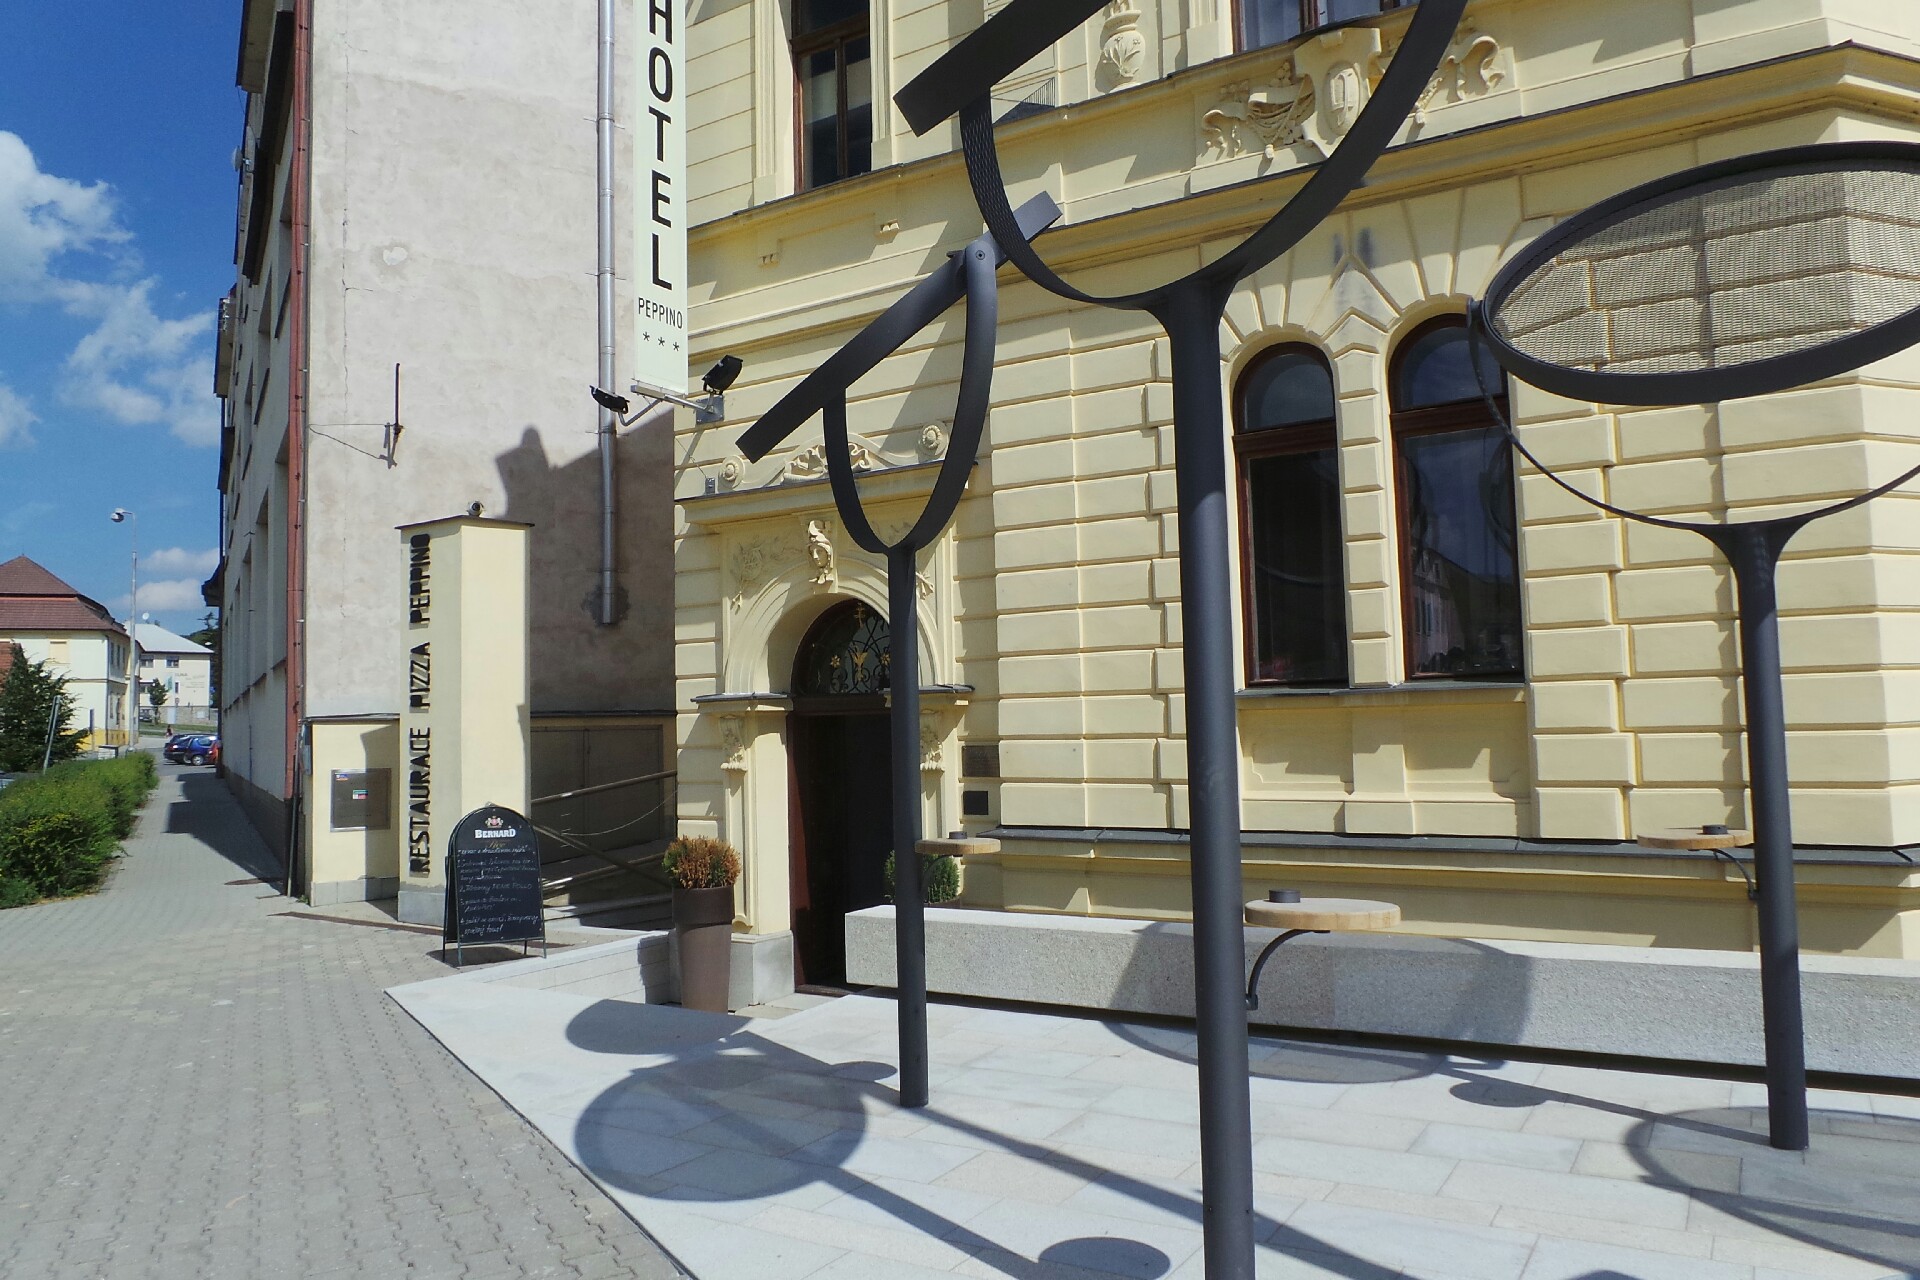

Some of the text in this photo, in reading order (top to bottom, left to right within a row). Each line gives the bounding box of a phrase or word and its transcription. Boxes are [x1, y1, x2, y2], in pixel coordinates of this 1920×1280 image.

[648, 0, 673, 290] HOTEL
[638, 297, 683, 329] PEPPINO
[410, 534, 431, 873] RESTAURACE PIZZA PEPPINO
[474, 829, 516, 838] BERNARD
